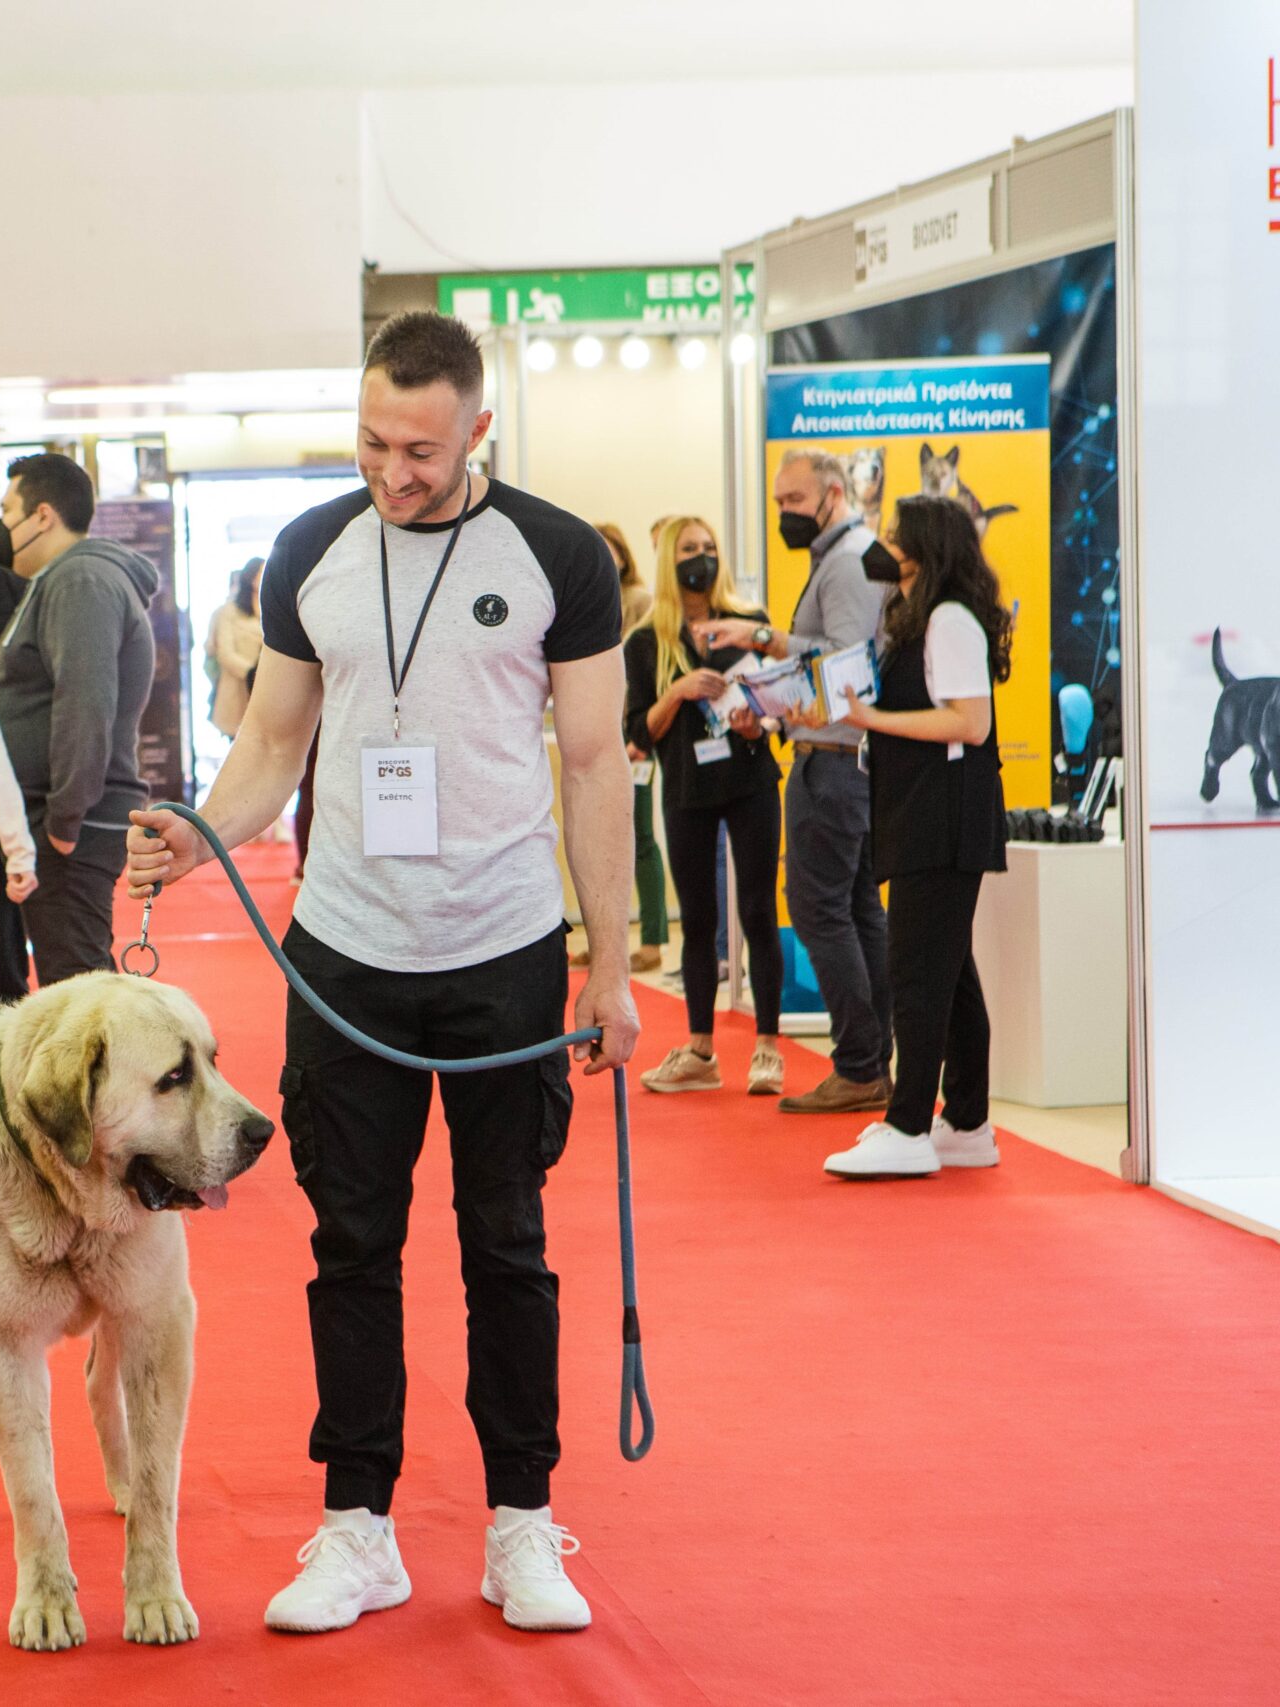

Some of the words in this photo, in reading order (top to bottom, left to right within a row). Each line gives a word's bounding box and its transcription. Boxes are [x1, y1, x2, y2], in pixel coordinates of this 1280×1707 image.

[803, 382, 917, 408] Κτηνιατρικά
[922, 379, 1012, 404] Προϊόντα
[792, 410, 944, 433] Αποκατάστασης
[949, 406, 1025, 430] Κίνησης
